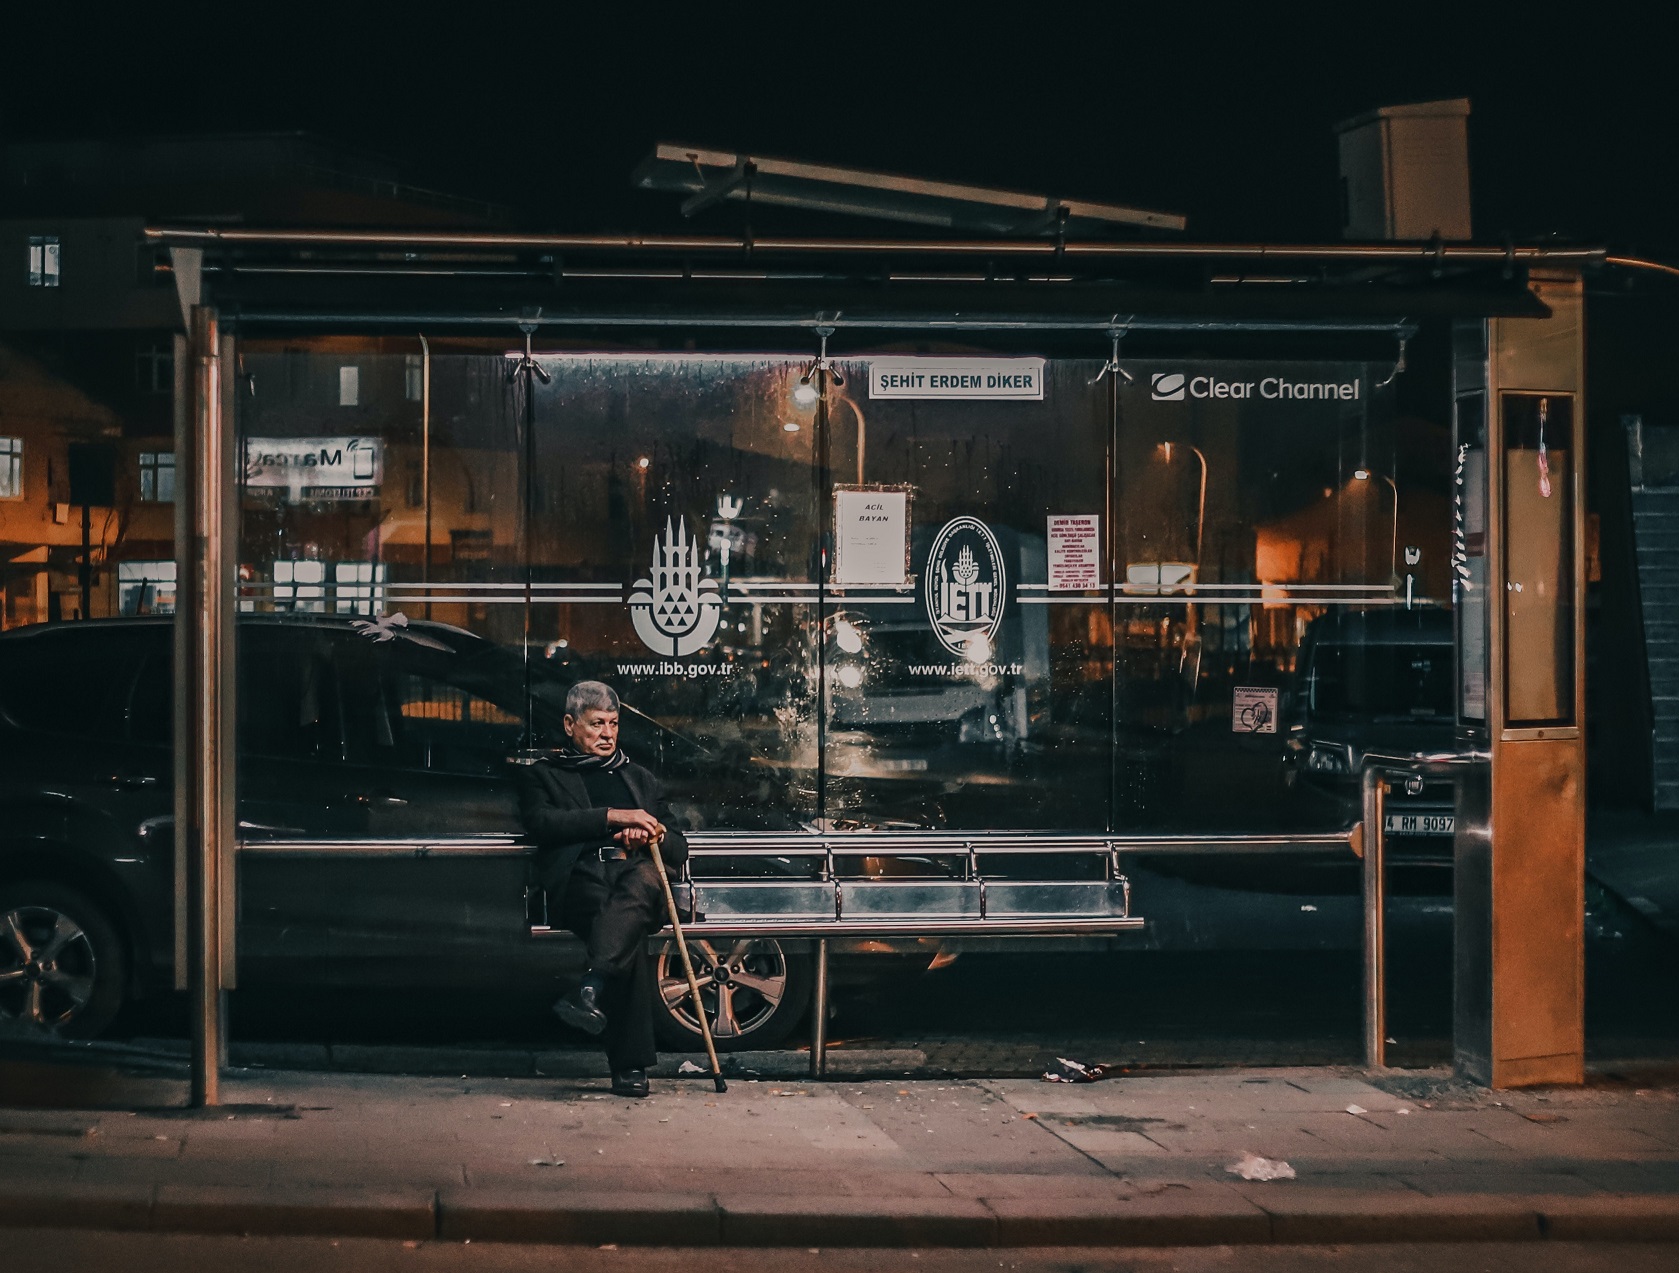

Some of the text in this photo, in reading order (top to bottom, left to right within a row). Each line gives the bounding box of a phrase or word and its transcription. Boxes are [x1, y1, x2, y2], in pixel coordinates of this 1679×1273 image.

[880, 372, 1033, 391] ŞEHİT ERDEM DİKER
[1189, 376, 1360, 399] Clear Channel
[865, 503, 884, 511] ACİL
[1070, 519, 1091, 527] TAŞERON
[616, 661, 733, 678] www.ibb.gov.tr
[908, 662, 1023, 678] www.iett.gov.tr
[1423, 817, 1454, 831] 9097
